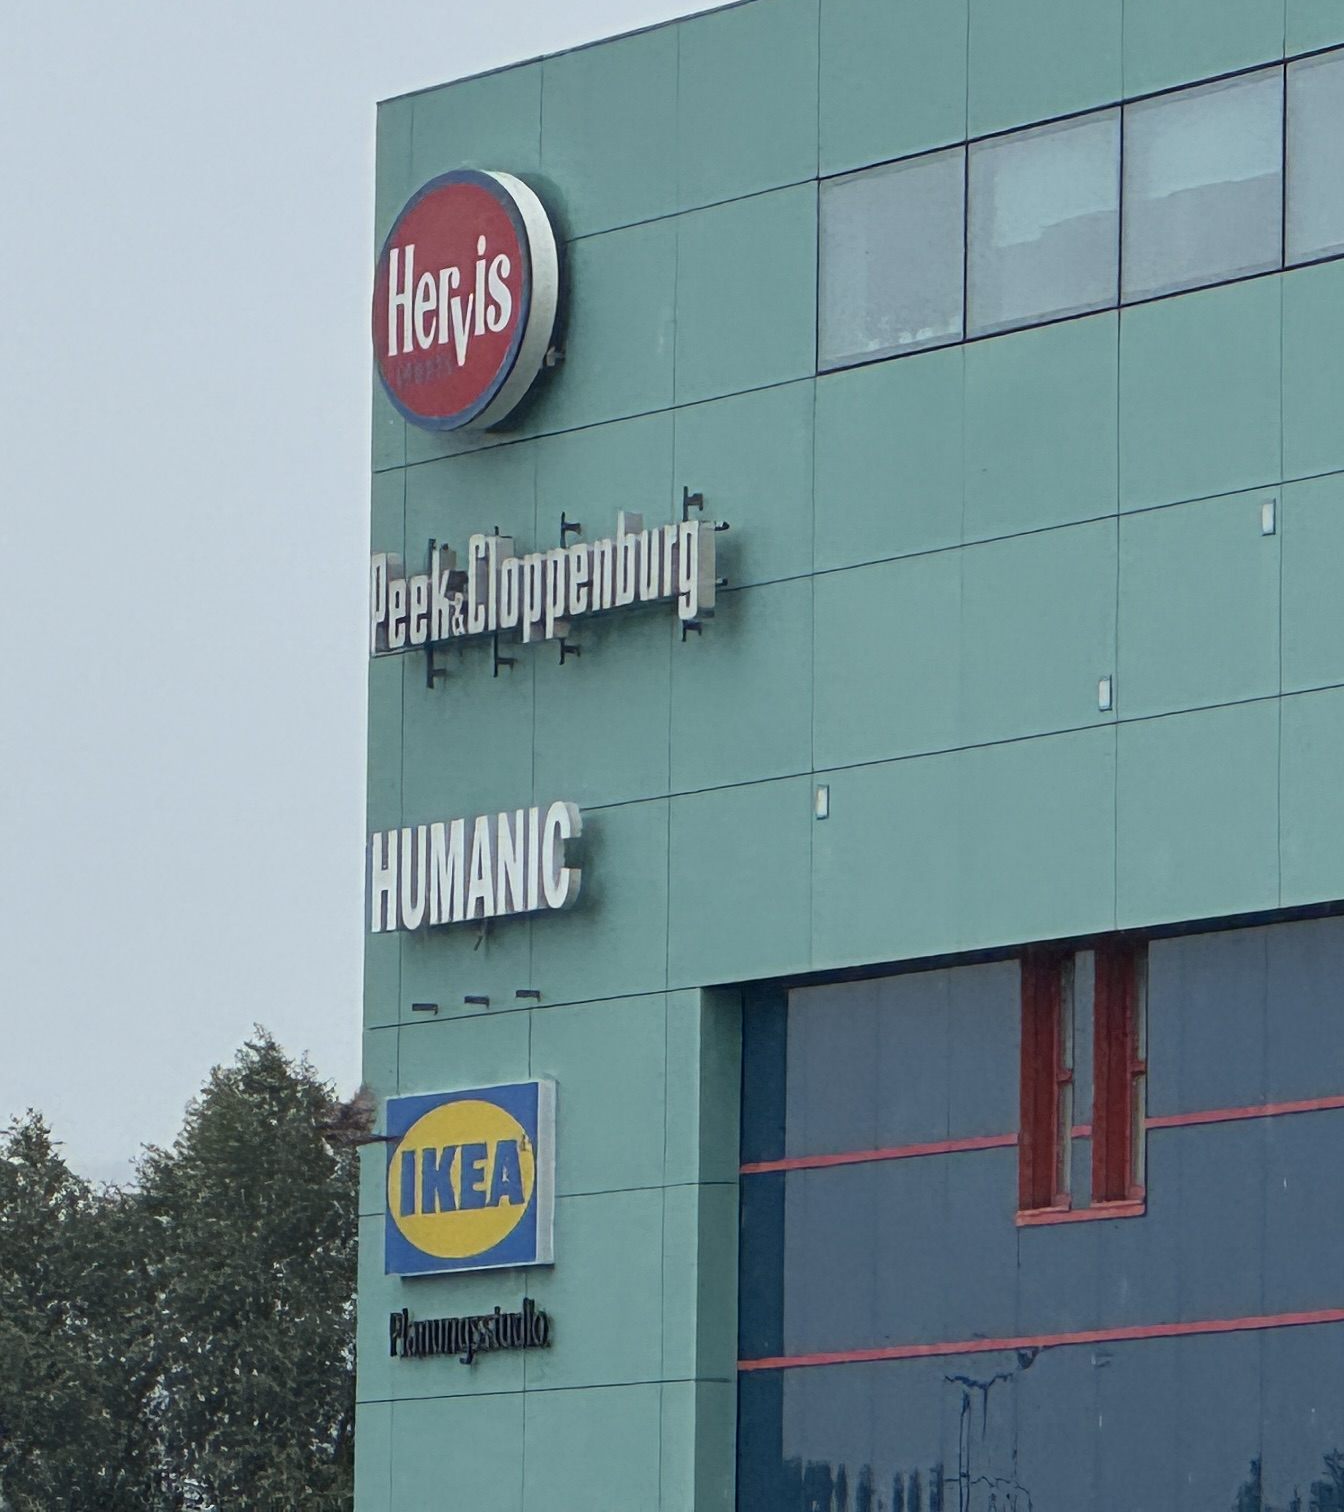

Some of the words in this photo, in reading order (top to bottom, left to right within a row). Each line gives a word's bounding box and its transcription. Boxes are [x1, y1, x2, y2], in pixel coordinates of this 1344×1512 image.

[387, 234, 512, 367] Hervis
[371, 800, 575, 933] HUMANIC
[401, 1138, 526, 1218] IKEA
